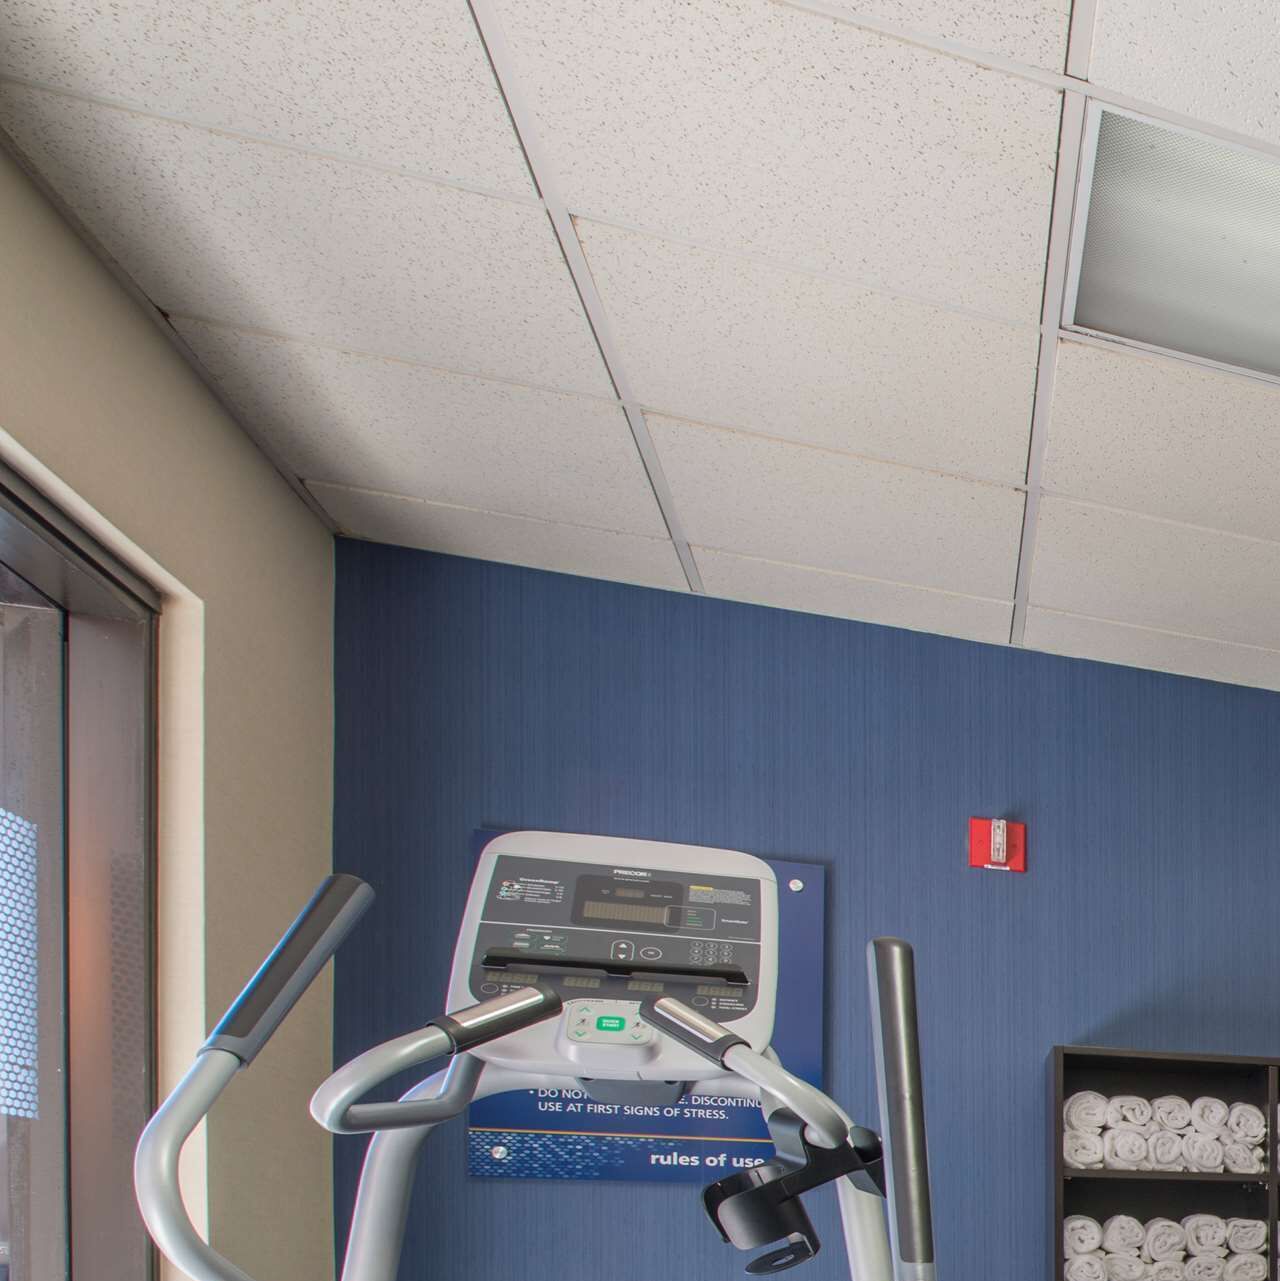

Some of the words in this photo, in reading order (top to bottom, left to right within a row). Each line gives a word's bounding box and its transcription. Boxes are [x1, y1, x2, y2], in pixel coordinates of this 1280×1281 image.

[538, 1087, 559, 1098] DO
[692, 1096, 761, 1108] DISCONTINU
[538, 1101, 563, 1112] USE
[566, 1103, 583, 1113] AT
[587, 1104, 620, 1115] FIRST
[624, 1106, 660, 1117] SIGNS
[664, 1107, 680, 1117] OF
[683, 1108, 729, 1120] STRESS.
[650, 1151, 700, 1166] rules
[705, 1153, 727, 1167] of
[732, 1157, 765, 1168] use
